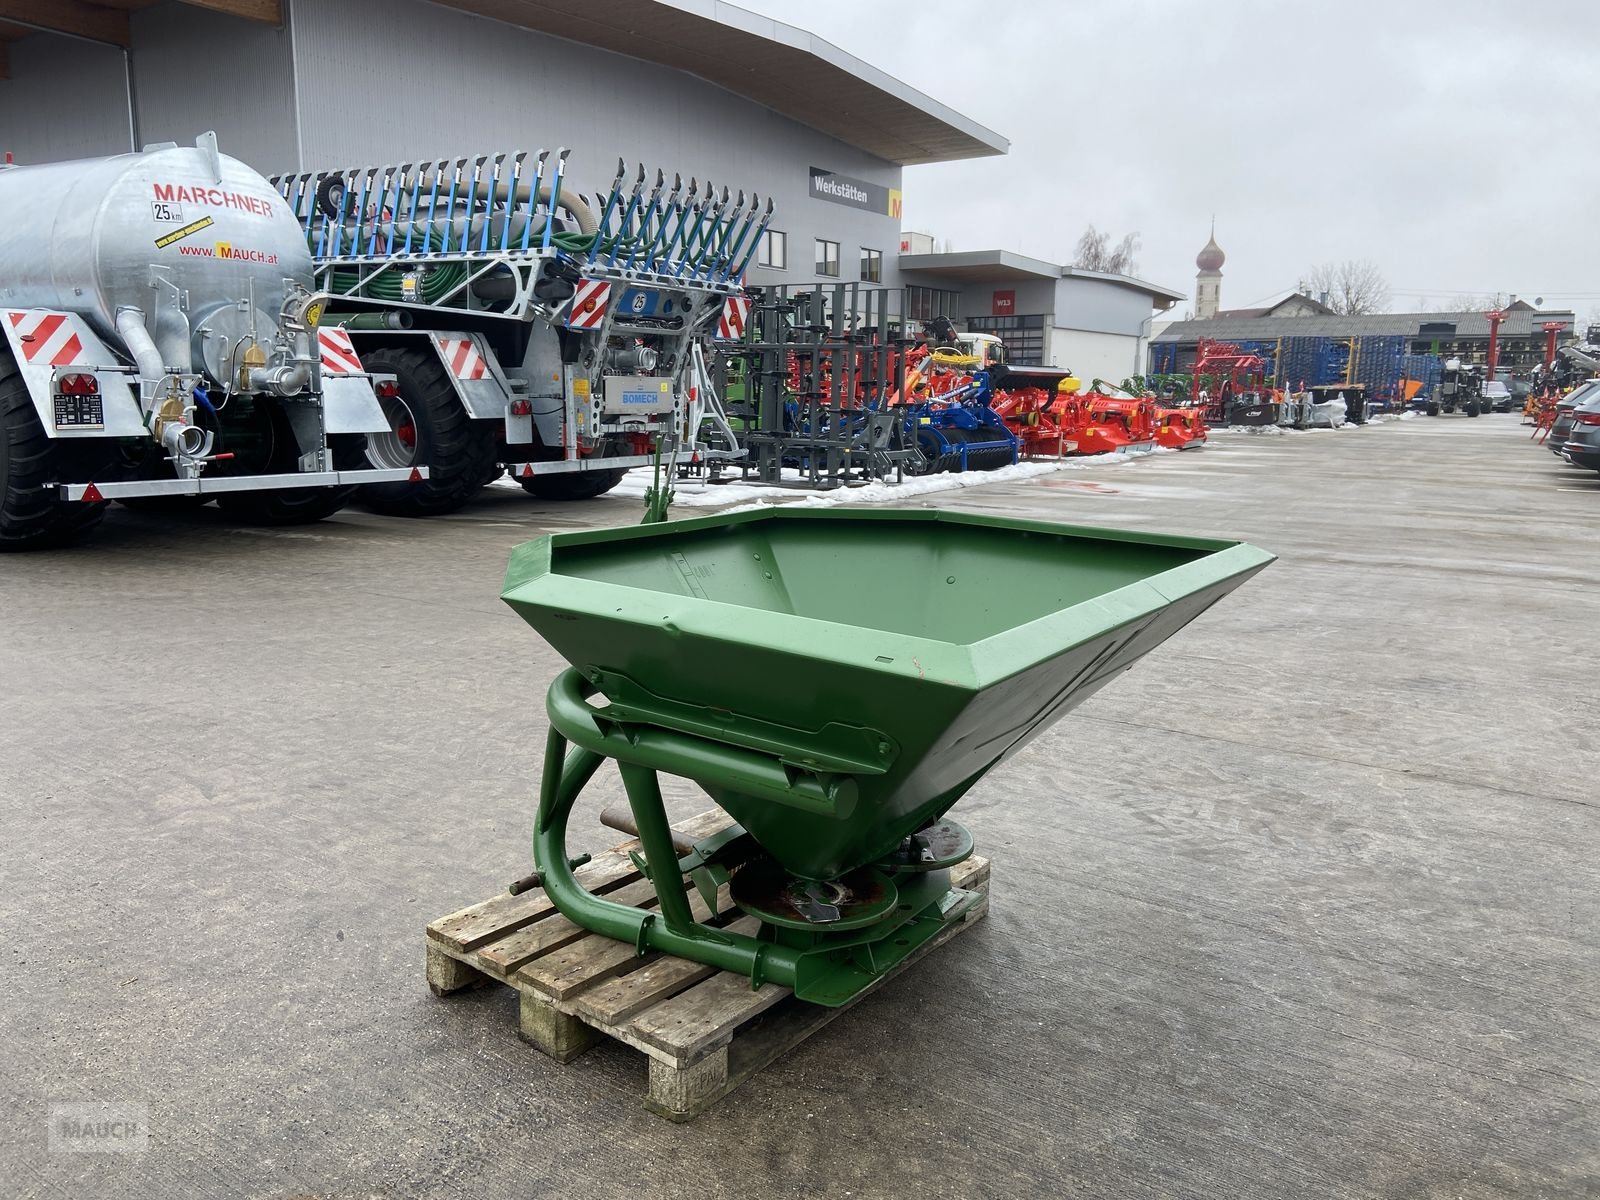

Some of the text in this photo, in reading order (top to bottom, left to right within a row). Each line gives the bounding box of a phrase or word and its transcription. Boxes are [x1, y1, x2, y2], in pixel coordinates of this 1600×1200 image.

[815, 176, 867, 203] Werkstätten
[153, 184, 273, 217] MARCHNER
[154, 204, 182, 220] 25 km
[634, 295, 645, 308] 25
[623, 393, 658, 404] BOMECH
